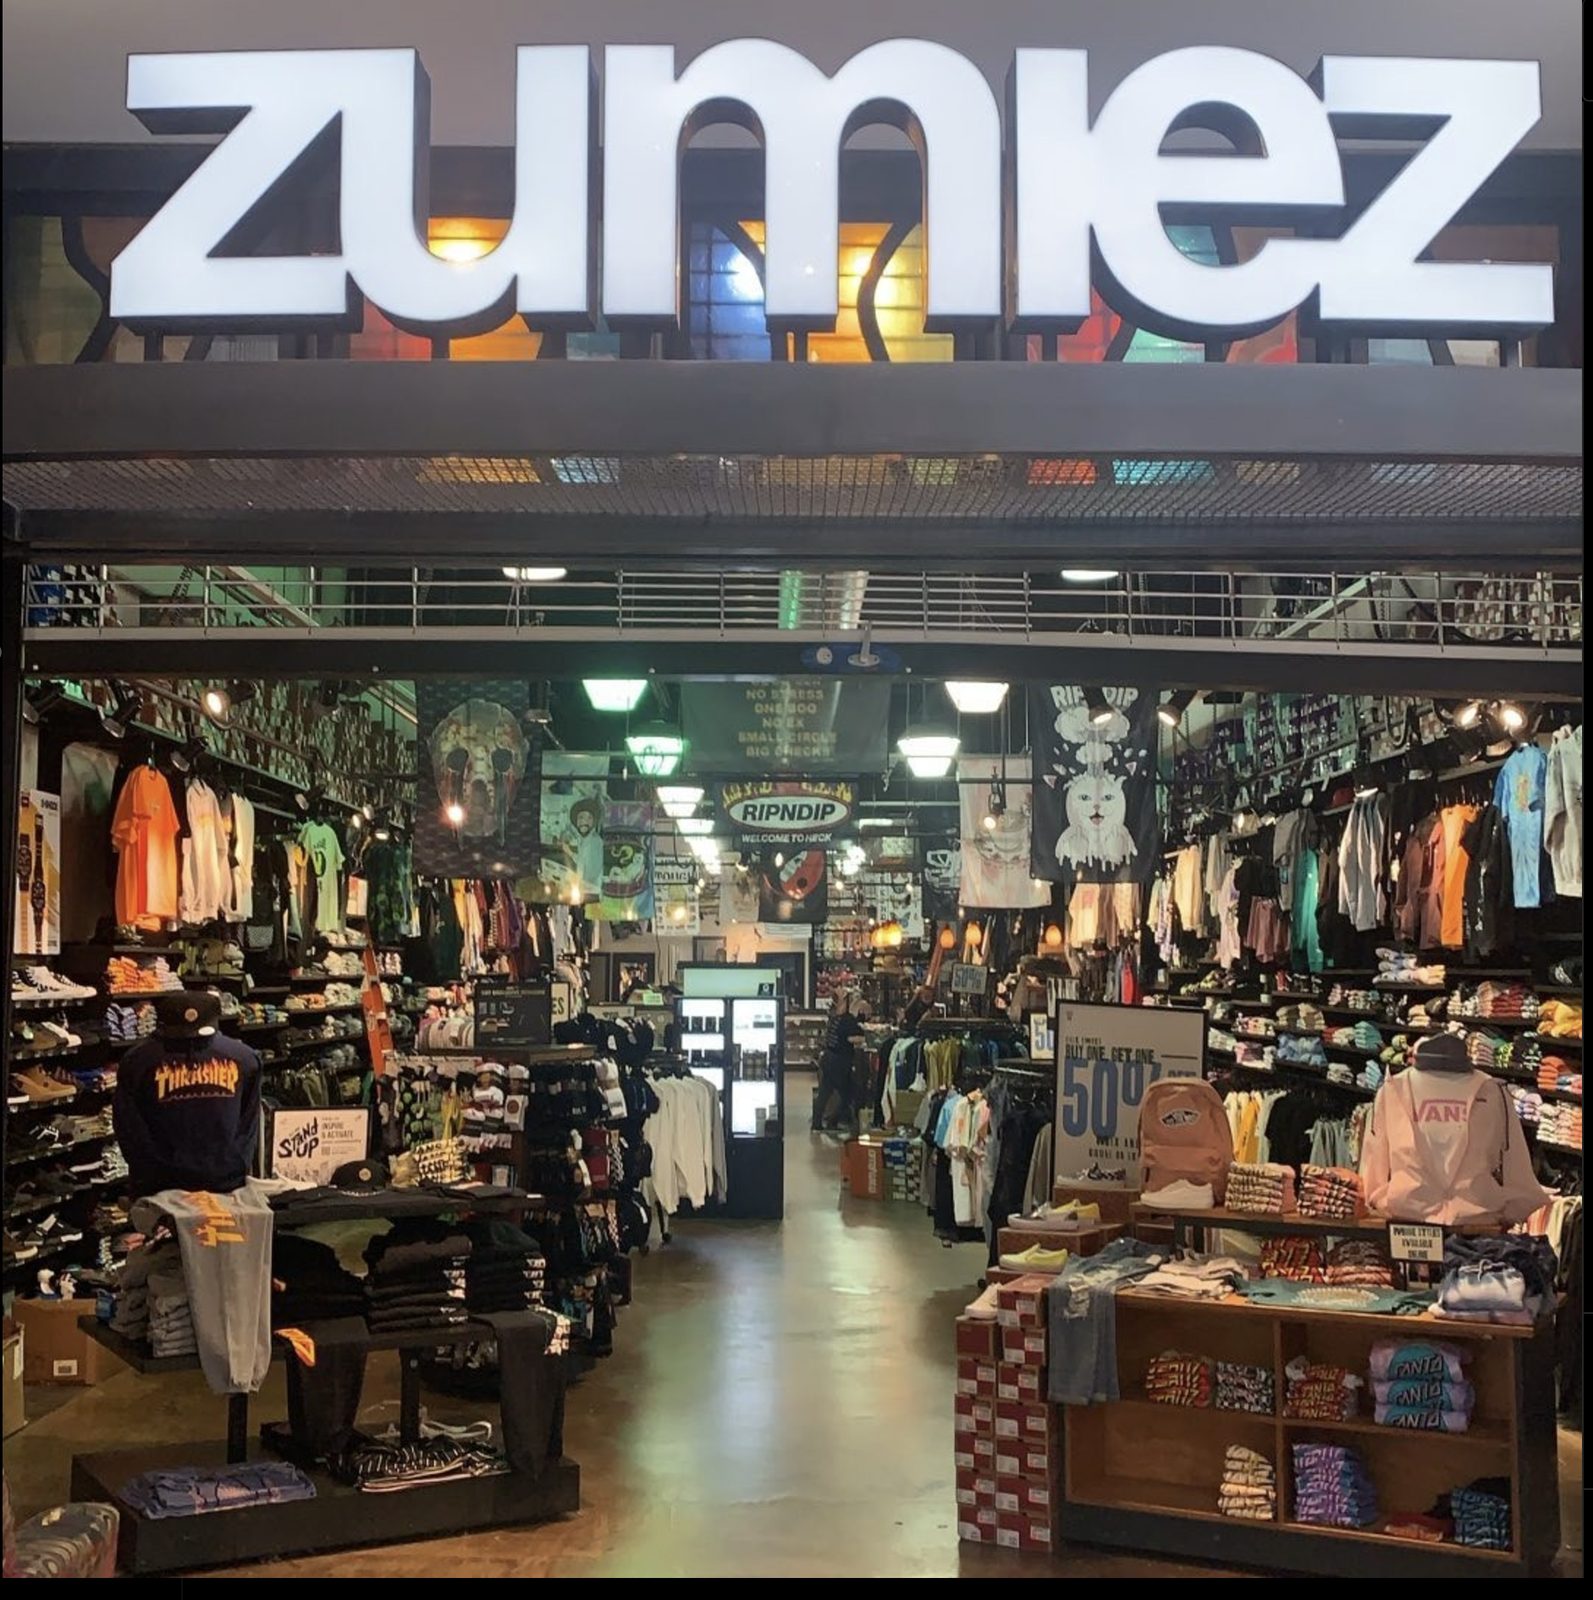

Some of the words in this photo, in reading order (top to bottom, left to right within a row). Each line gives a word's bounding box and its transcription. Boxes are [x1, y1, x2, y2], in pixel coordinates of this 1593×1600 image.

[109, 37, 1555, 329] zumiez
[745, 689, 767, 700] NO
[770, 689, 825, 700] STRESS
[754, 702, 783, 713] ONE
[762, 717, 782, 728] NO
[738, 731, 783, 743] SMALL
[786, 731, 837, 743] CIRCLE
[745, 746, 770, 757] BIG
[741, 803, 836, 821] RIPNDIP
[741, 834, 790, 843] WELCOME
[790, 833, 805, 843] TO
[1065, 1044, 1084, 1060] BUY
[1111, 1047, 1133, 1063] GET
[154, 1057, 239, 1099] THRASHER
[321, 1122, 344, 1130] INSPIRE
[327, 1130, 353, 1139] ACTIVATE
[296, 1137, 320, 1159] UP
